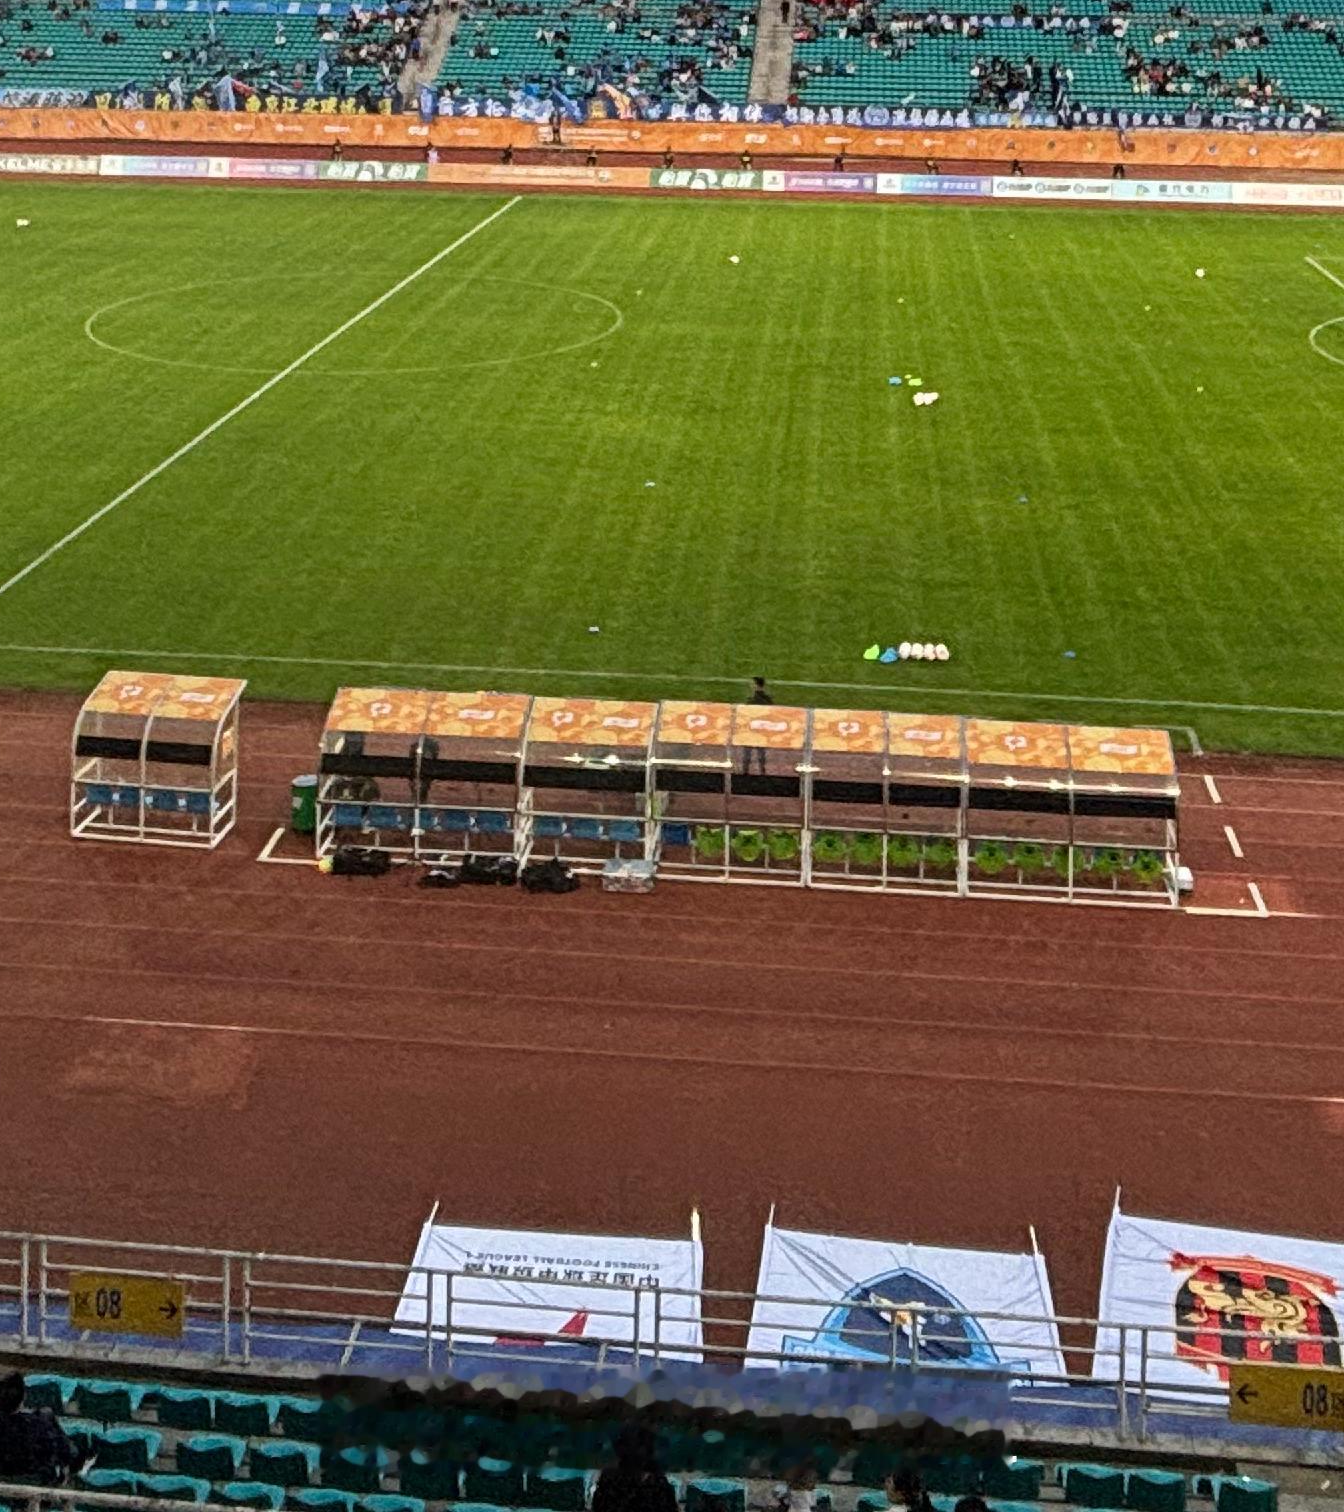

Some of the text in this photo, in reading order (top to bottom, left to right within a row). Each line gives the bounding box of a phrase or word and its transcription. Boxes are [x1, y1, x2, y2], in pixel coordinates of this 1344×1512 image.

[534, 1256, 601, 1267] FOOTBALL
[95, 1288, 122, 1320] 08
[1302, 1383, 1328, 1418] 08
